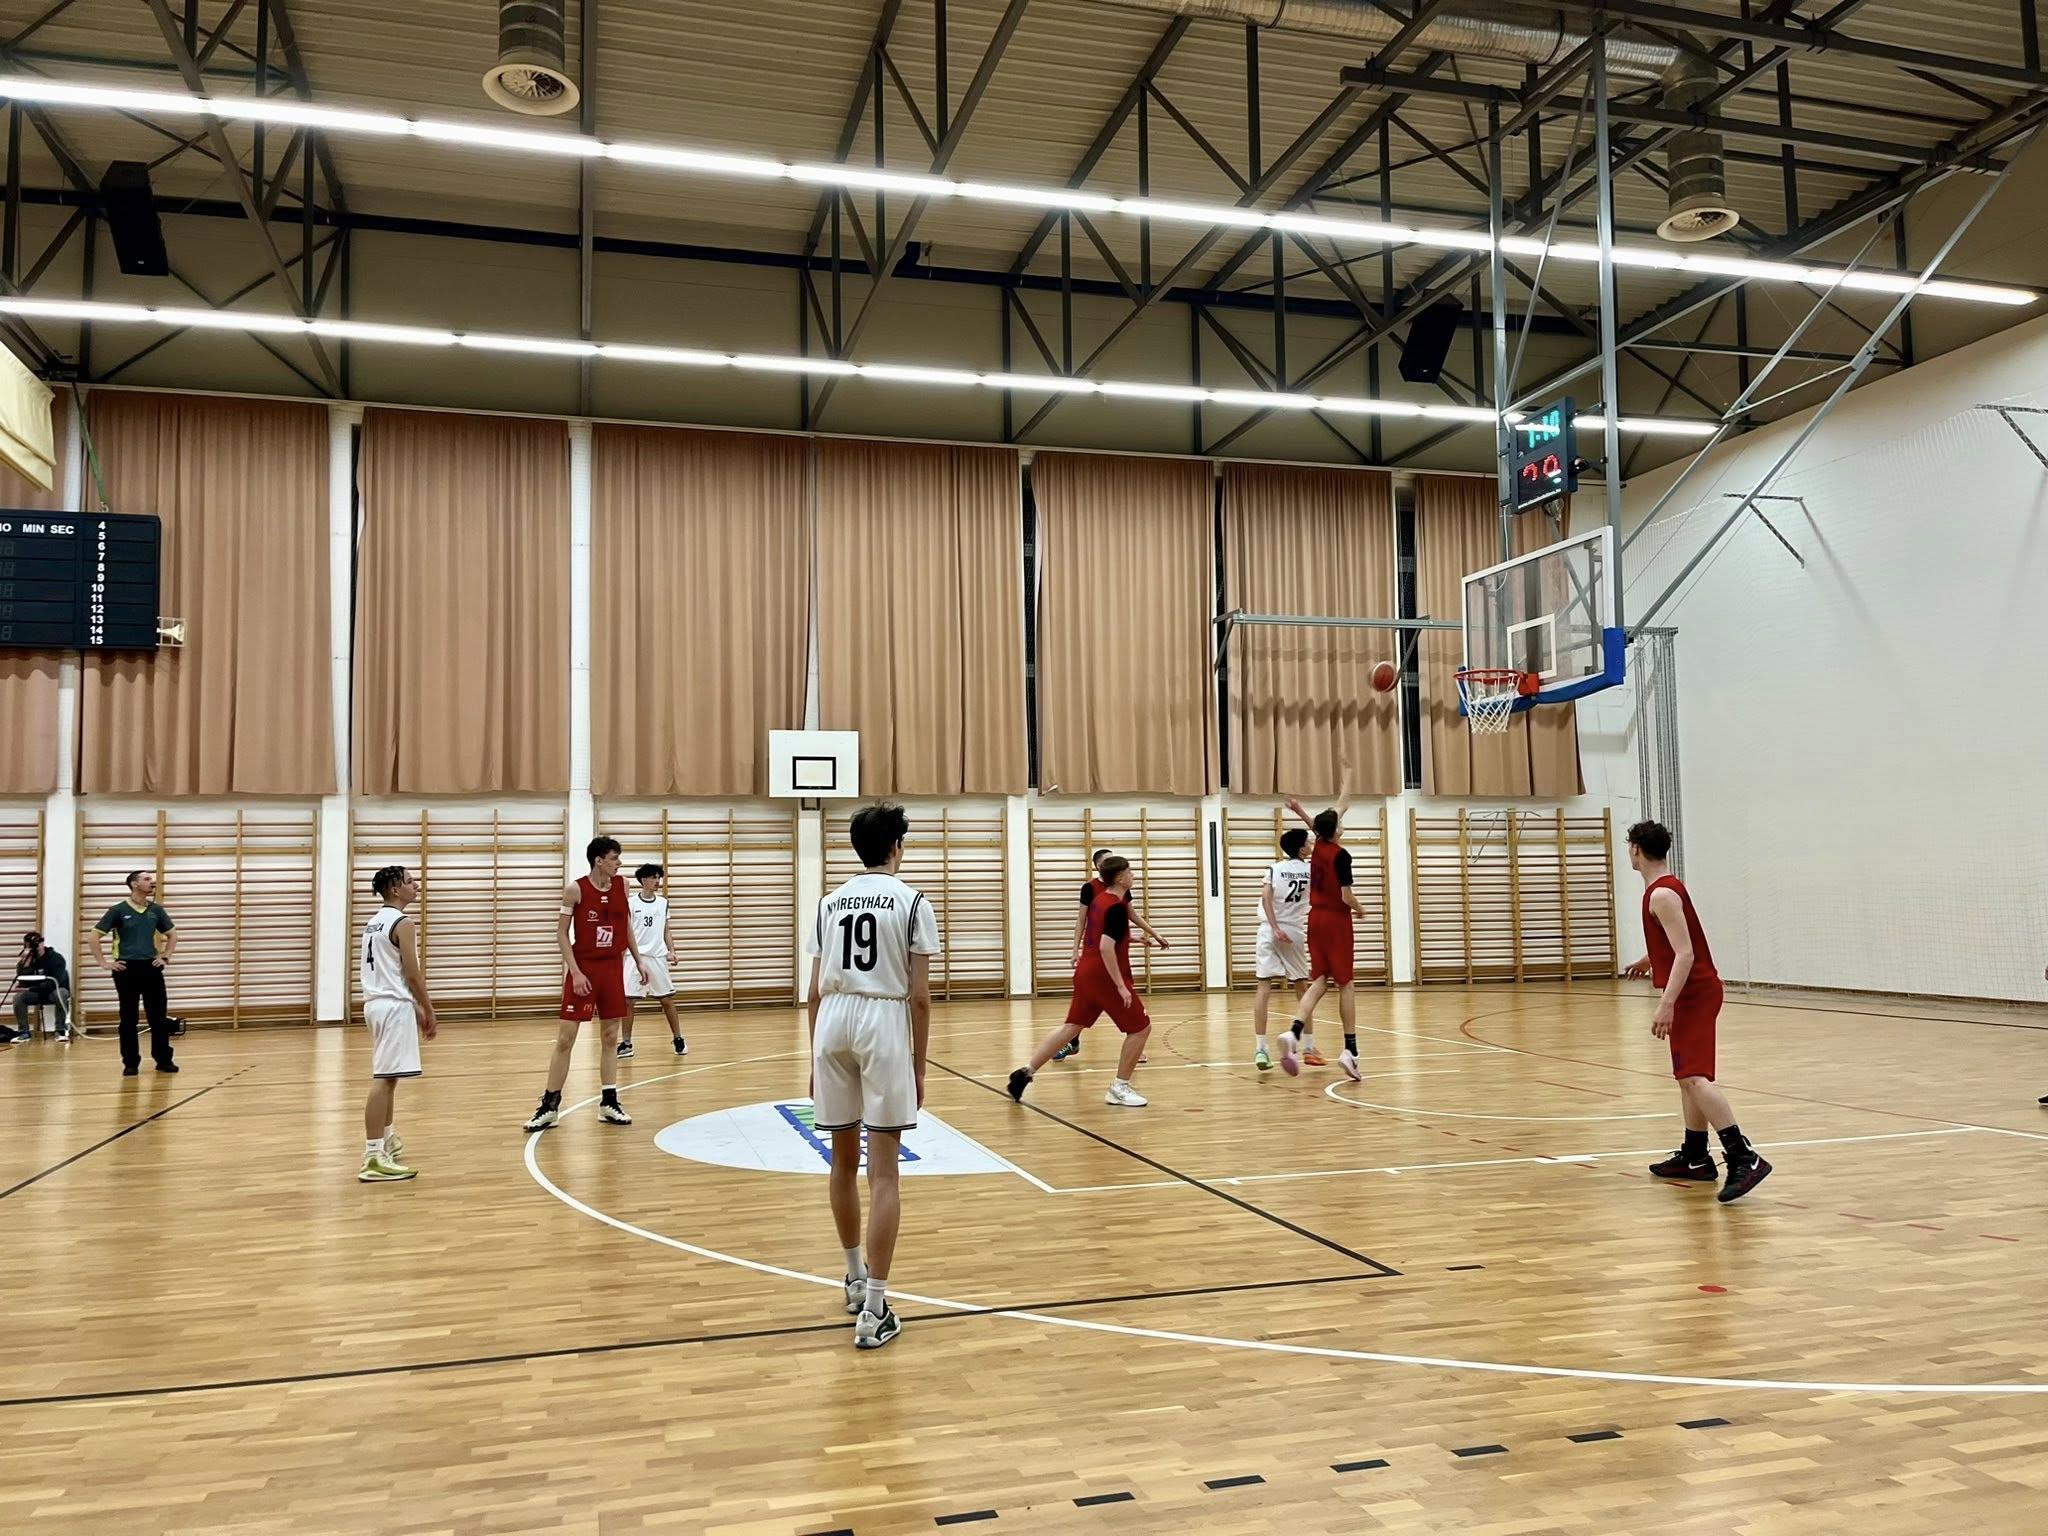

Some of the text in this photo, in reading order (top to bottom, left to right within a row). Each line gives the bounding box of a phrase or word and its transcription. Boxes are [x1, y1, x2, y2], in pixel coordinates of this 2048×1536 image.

[22, 523, 45, 534] MIN
[50, 524, 75, 535] SEC
[97, 521, 106, 530] 4
[97, 531, 106, 541] 5
[97, 541, 106, 551] 6
[97, 552, 105, 561] 7
[97, 562, 105, 572] 8
[96, 572, 105, 582] 9
[91, 583, 105, 593] 10
[90, 593, 103, 603] 11
[90, 604, 105, 614] 12
[90, 614, 104, 624] 13
[89, 625, 104, 635] 14
[89, 635, 104, 645] 15
[1285, 880, 1307, 902] 25
[827, 893, 895, 913] NYÍREGYHÁZA
[643, 916, 654, 928] 38
[838, 912, 878, 972] 19
[367, 936, 374, 971] 4
